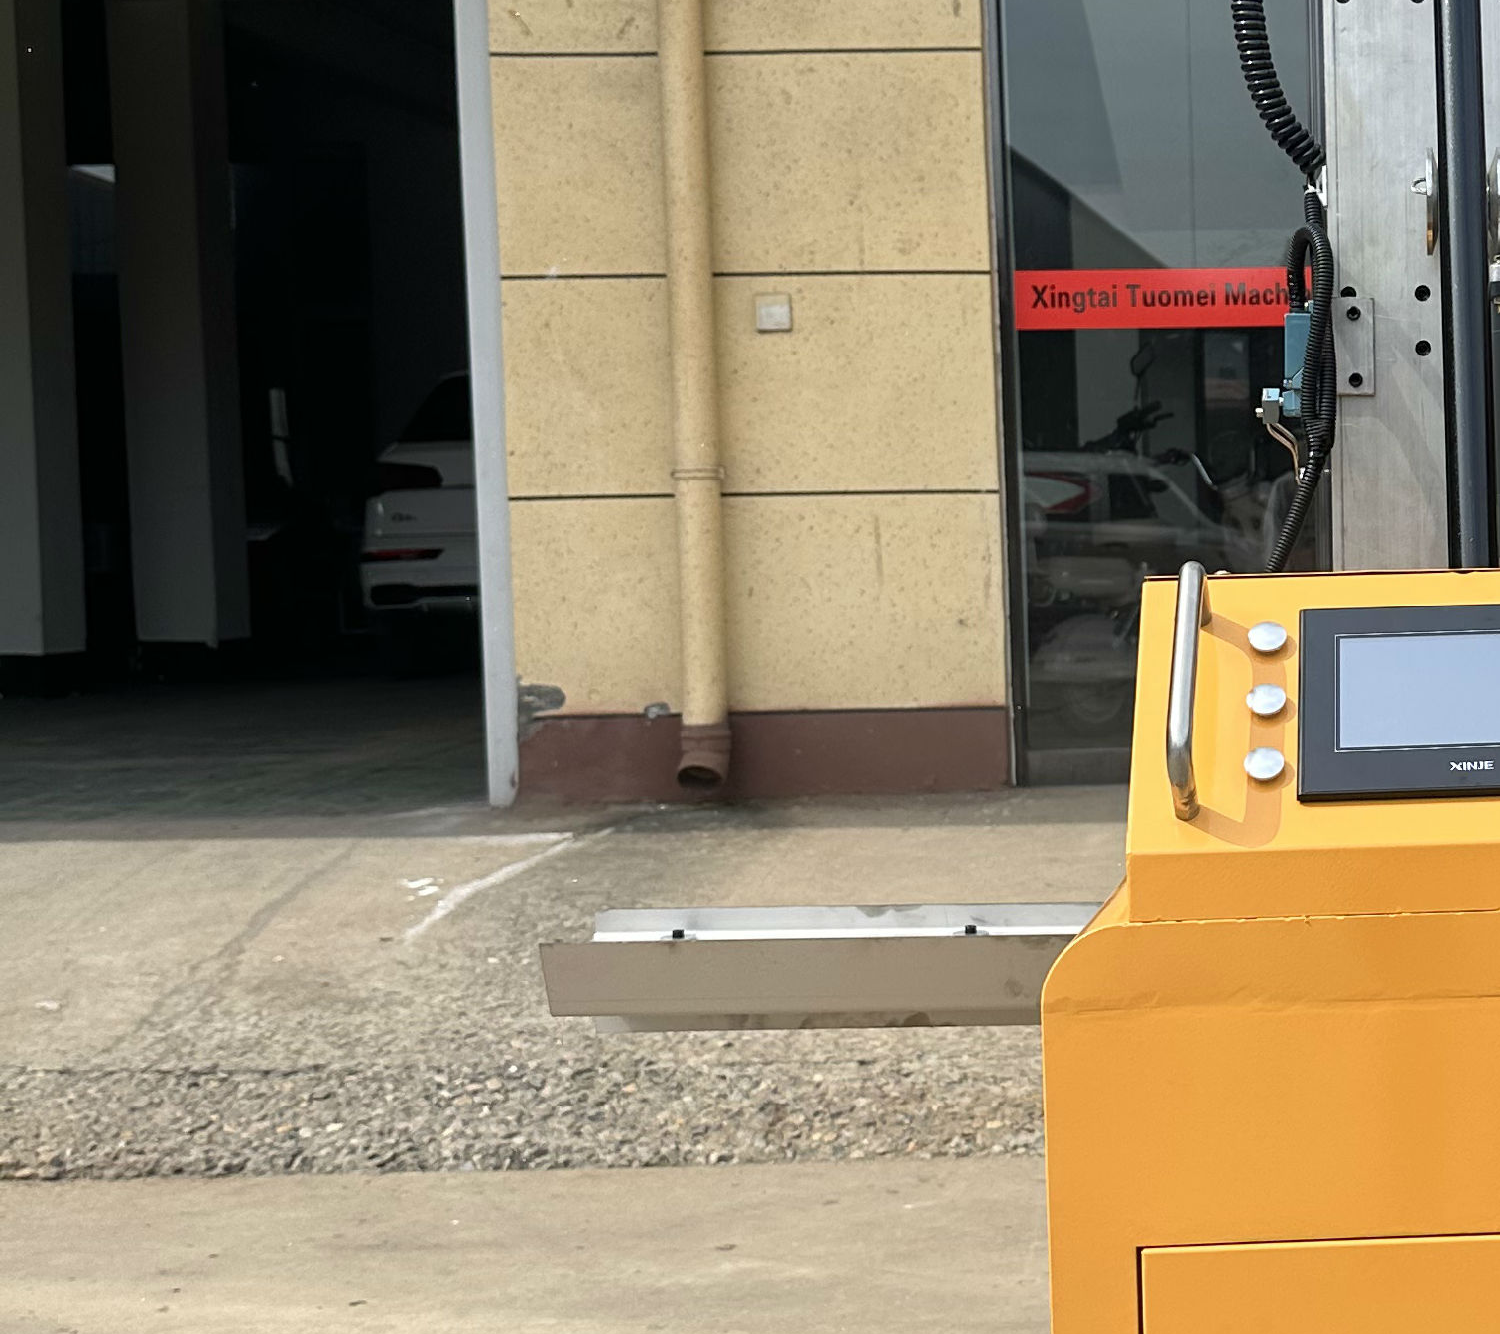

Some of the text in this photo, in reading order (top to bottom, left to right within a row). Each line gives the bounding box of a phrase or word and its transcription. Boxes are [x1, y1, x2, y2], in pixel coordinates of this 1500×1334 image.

[1031, 284, 1118, 313] Xingtai
[1125, 282, 1217, 308] Tuomei
[1449, 760, 1495, 771] XINJE
